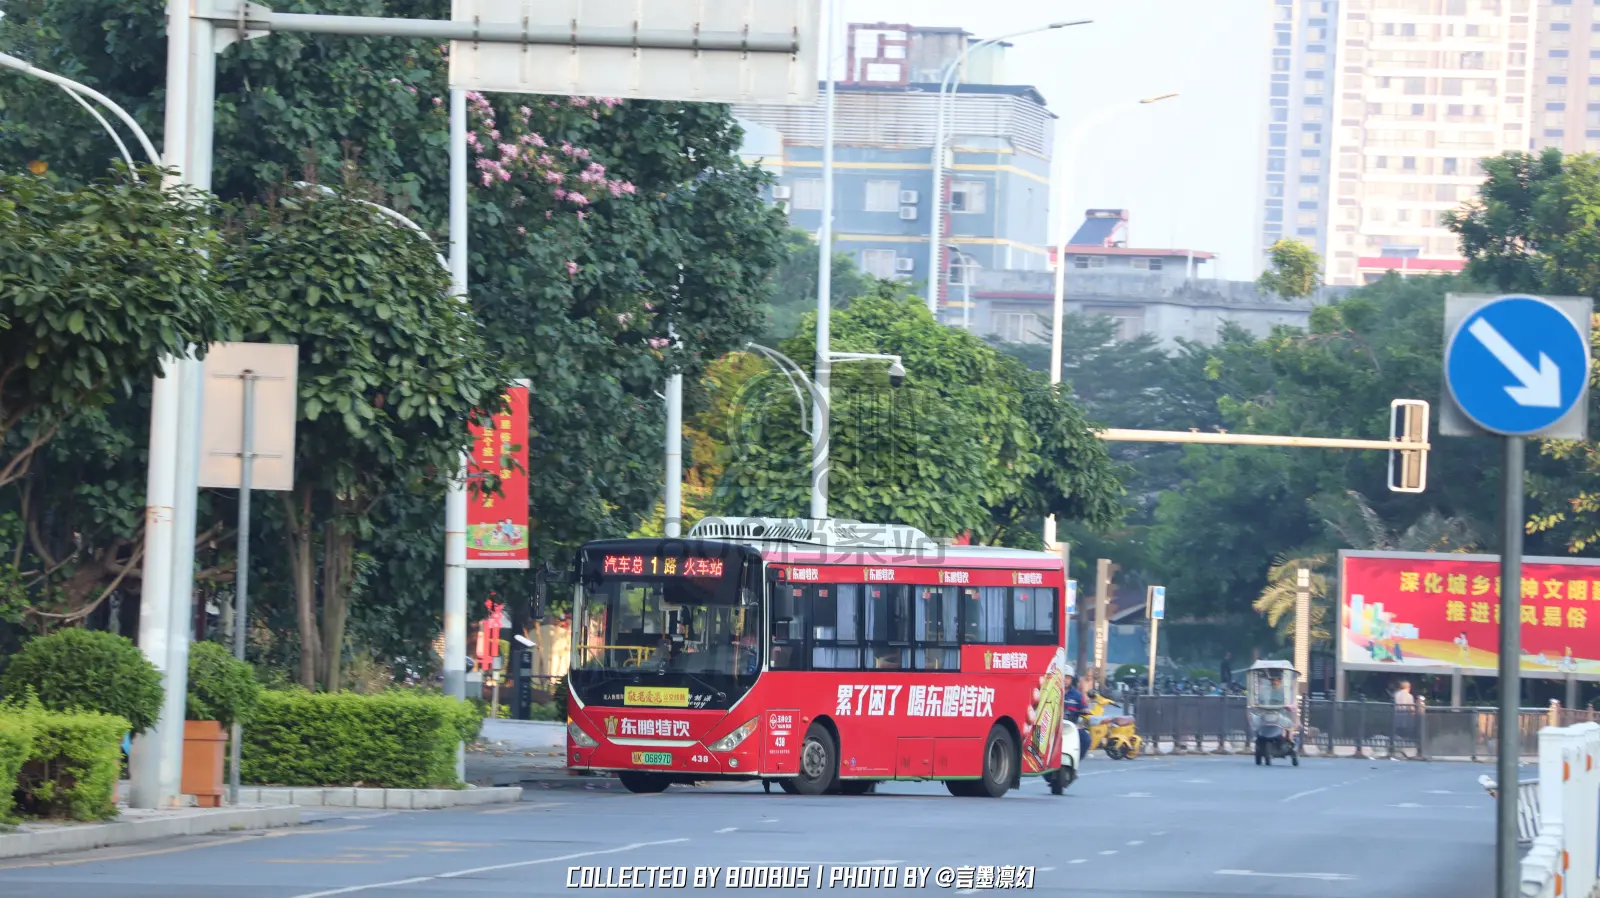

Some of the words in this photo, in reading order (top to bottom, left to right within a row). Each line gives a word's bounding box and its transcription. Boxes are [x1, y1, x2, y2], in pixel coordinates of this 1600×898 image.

[604, 555, 643, 574] 汽车总
[650, 556, 657, 574] 1
[664, 557, 677, 575] 路
[683, 557, 723, 577] 火车站
[992, 651, 1028, 669] 东鹏特饮
[835, 684, 903, 716] 累了困了
[906, 684, 996, 717] 喝东鹏特饮
[620, 717, 691, 737] 东鹏特饮
[691, 755, 709, 763] 438
